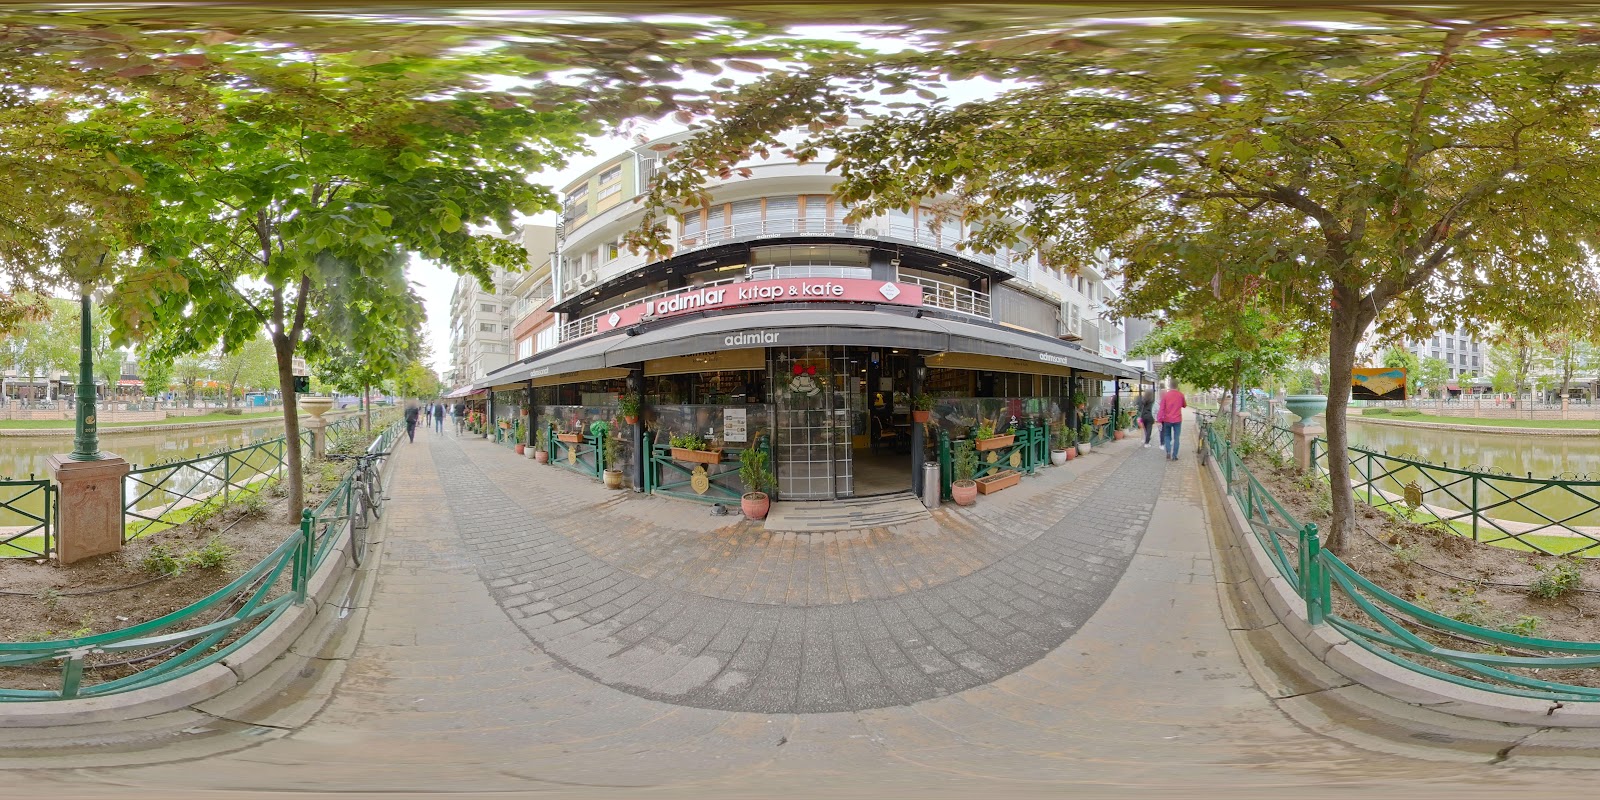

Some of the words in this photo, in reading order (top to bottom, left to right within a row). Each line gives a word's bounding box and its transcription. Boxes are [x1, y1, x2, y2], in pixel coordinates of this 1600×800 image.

[657, 288, 726, 314] adımlar
[788, 285, 798, 296] &
[802, 282, 844, 296] kafe
[724, 331, 780, 346] adımlar
